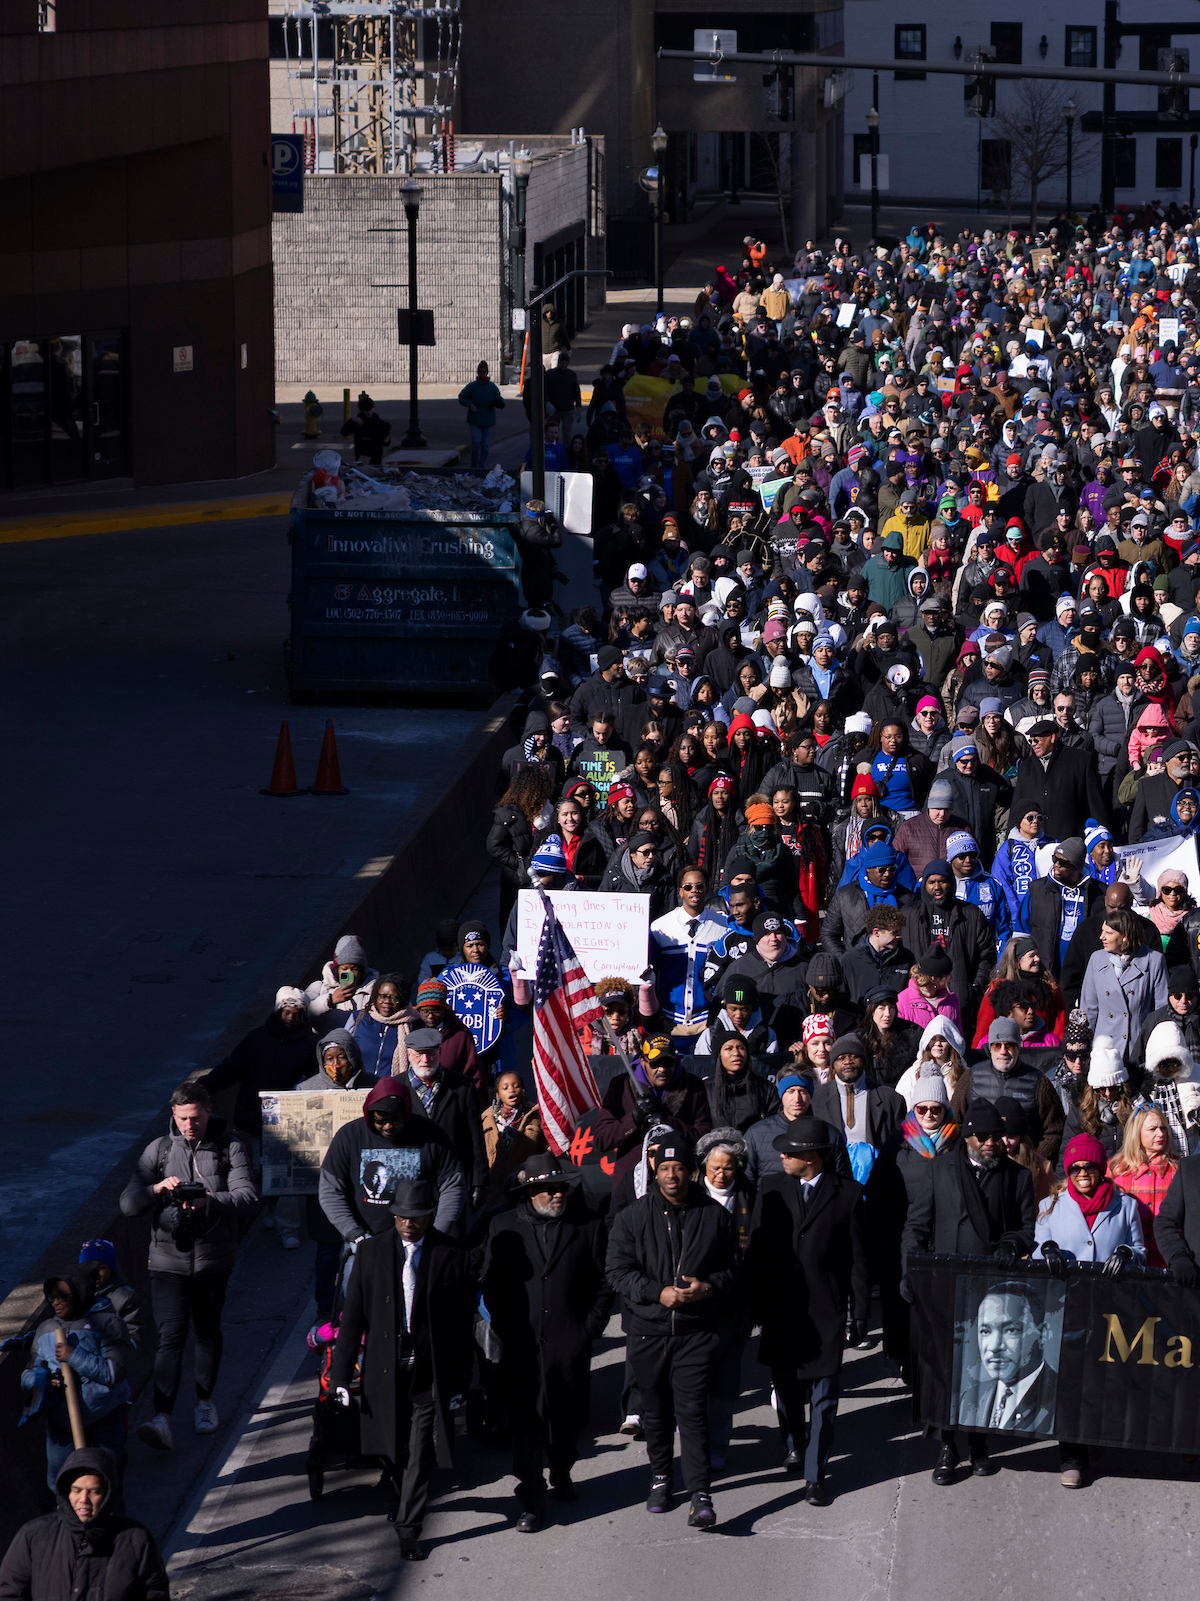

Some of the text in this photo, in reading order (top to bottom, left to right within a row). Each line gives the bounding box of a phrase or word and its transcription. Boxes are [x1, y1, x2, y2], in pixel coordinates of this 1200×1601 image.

[328, 535, 495, 559] Innovative Crushing
[357, 584, 448, 604] Aggregate,
[593, 751, 610, 761] THE
[580, 761, 616, 772] TIME IS
[586, 771, 621, 782] ALWA
[524, 895, 645, 917] Silcing Ones Truth
[560, 920, 612, 930] IOLATION
[573, 936, 621, 950] RIGHTS!
[593, 959, 640, 972] Corruption!
